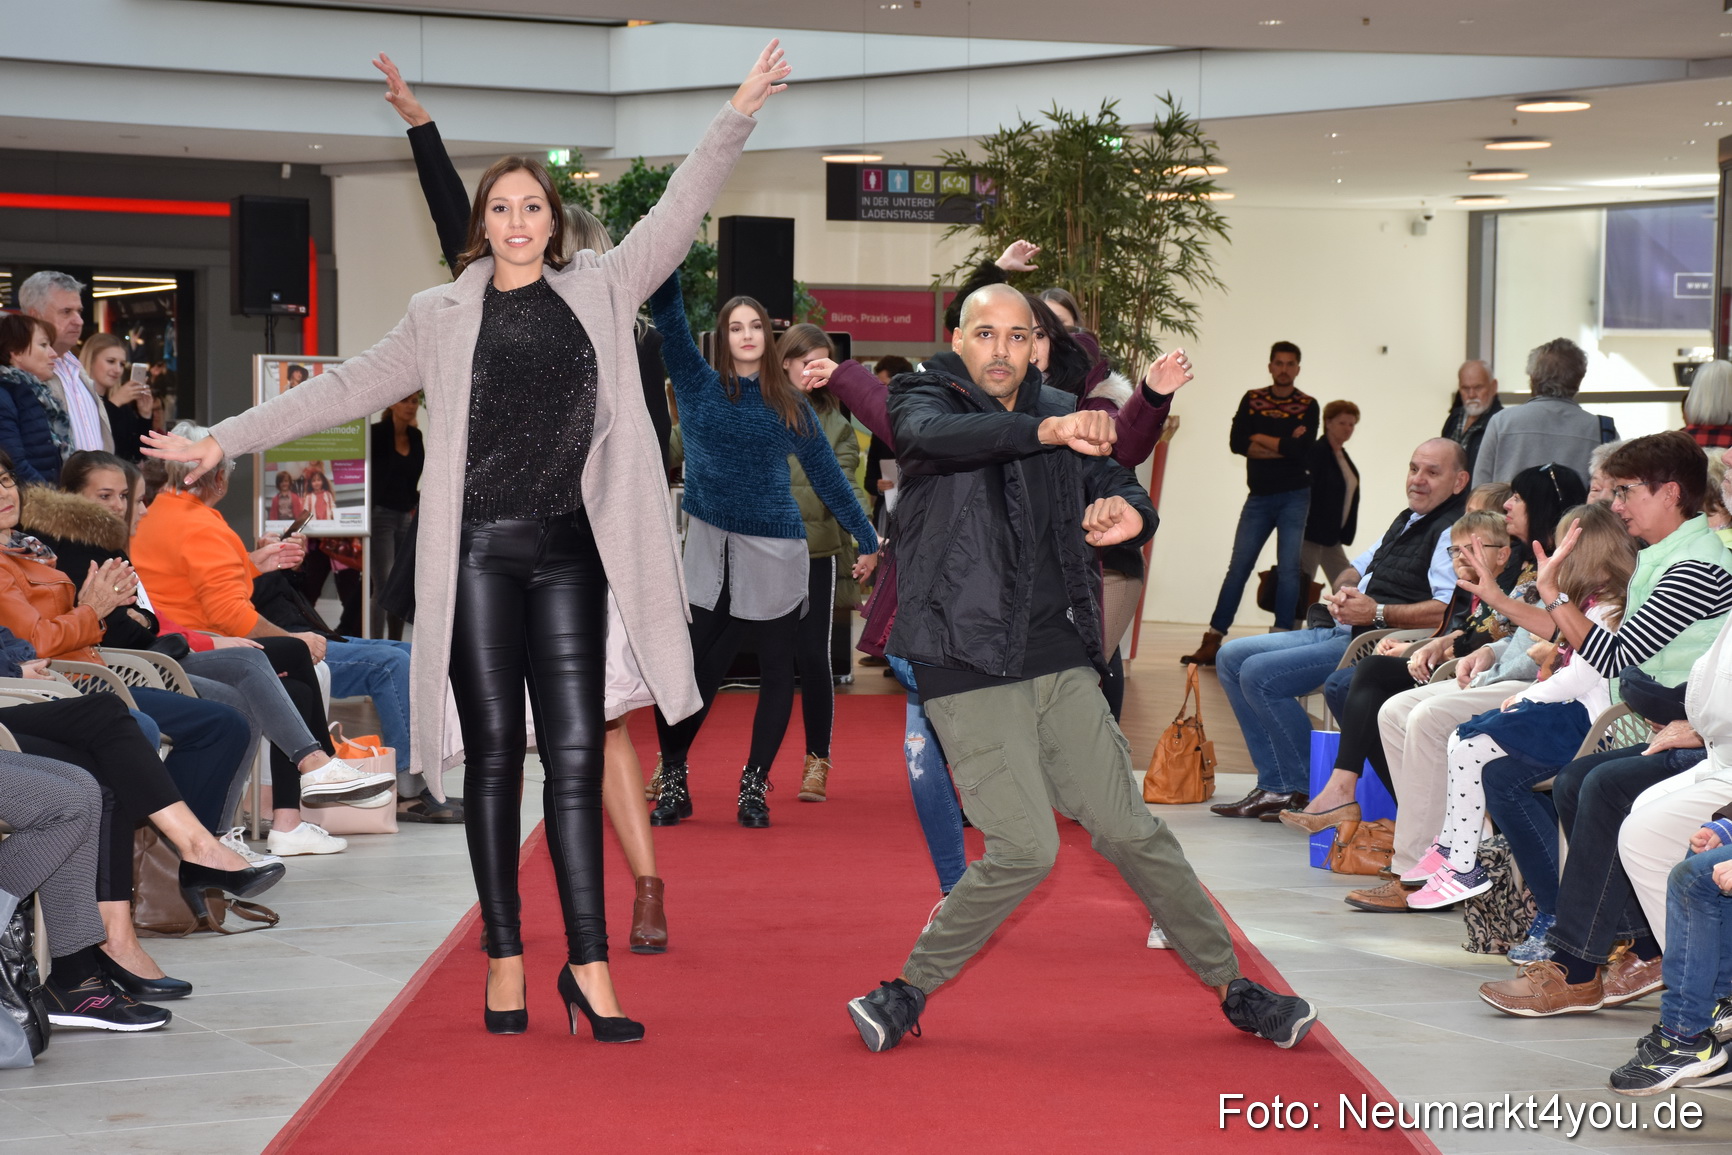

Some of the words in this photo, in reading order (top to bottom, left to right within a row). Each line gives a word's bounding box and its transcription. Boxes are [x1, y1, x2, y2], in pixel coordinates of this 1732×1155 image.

[861, 197, 871, 206] IN
[872, 197, 889, 206] DER
[893, 198, 935, 207] UNTEREN
[861, 209, 935, 220] LADENSTRASSE
[831, 312, 859, 323] Büro-,
[860, 313, 892, 323] Praxis-
[893, 314, 911, 323] und
